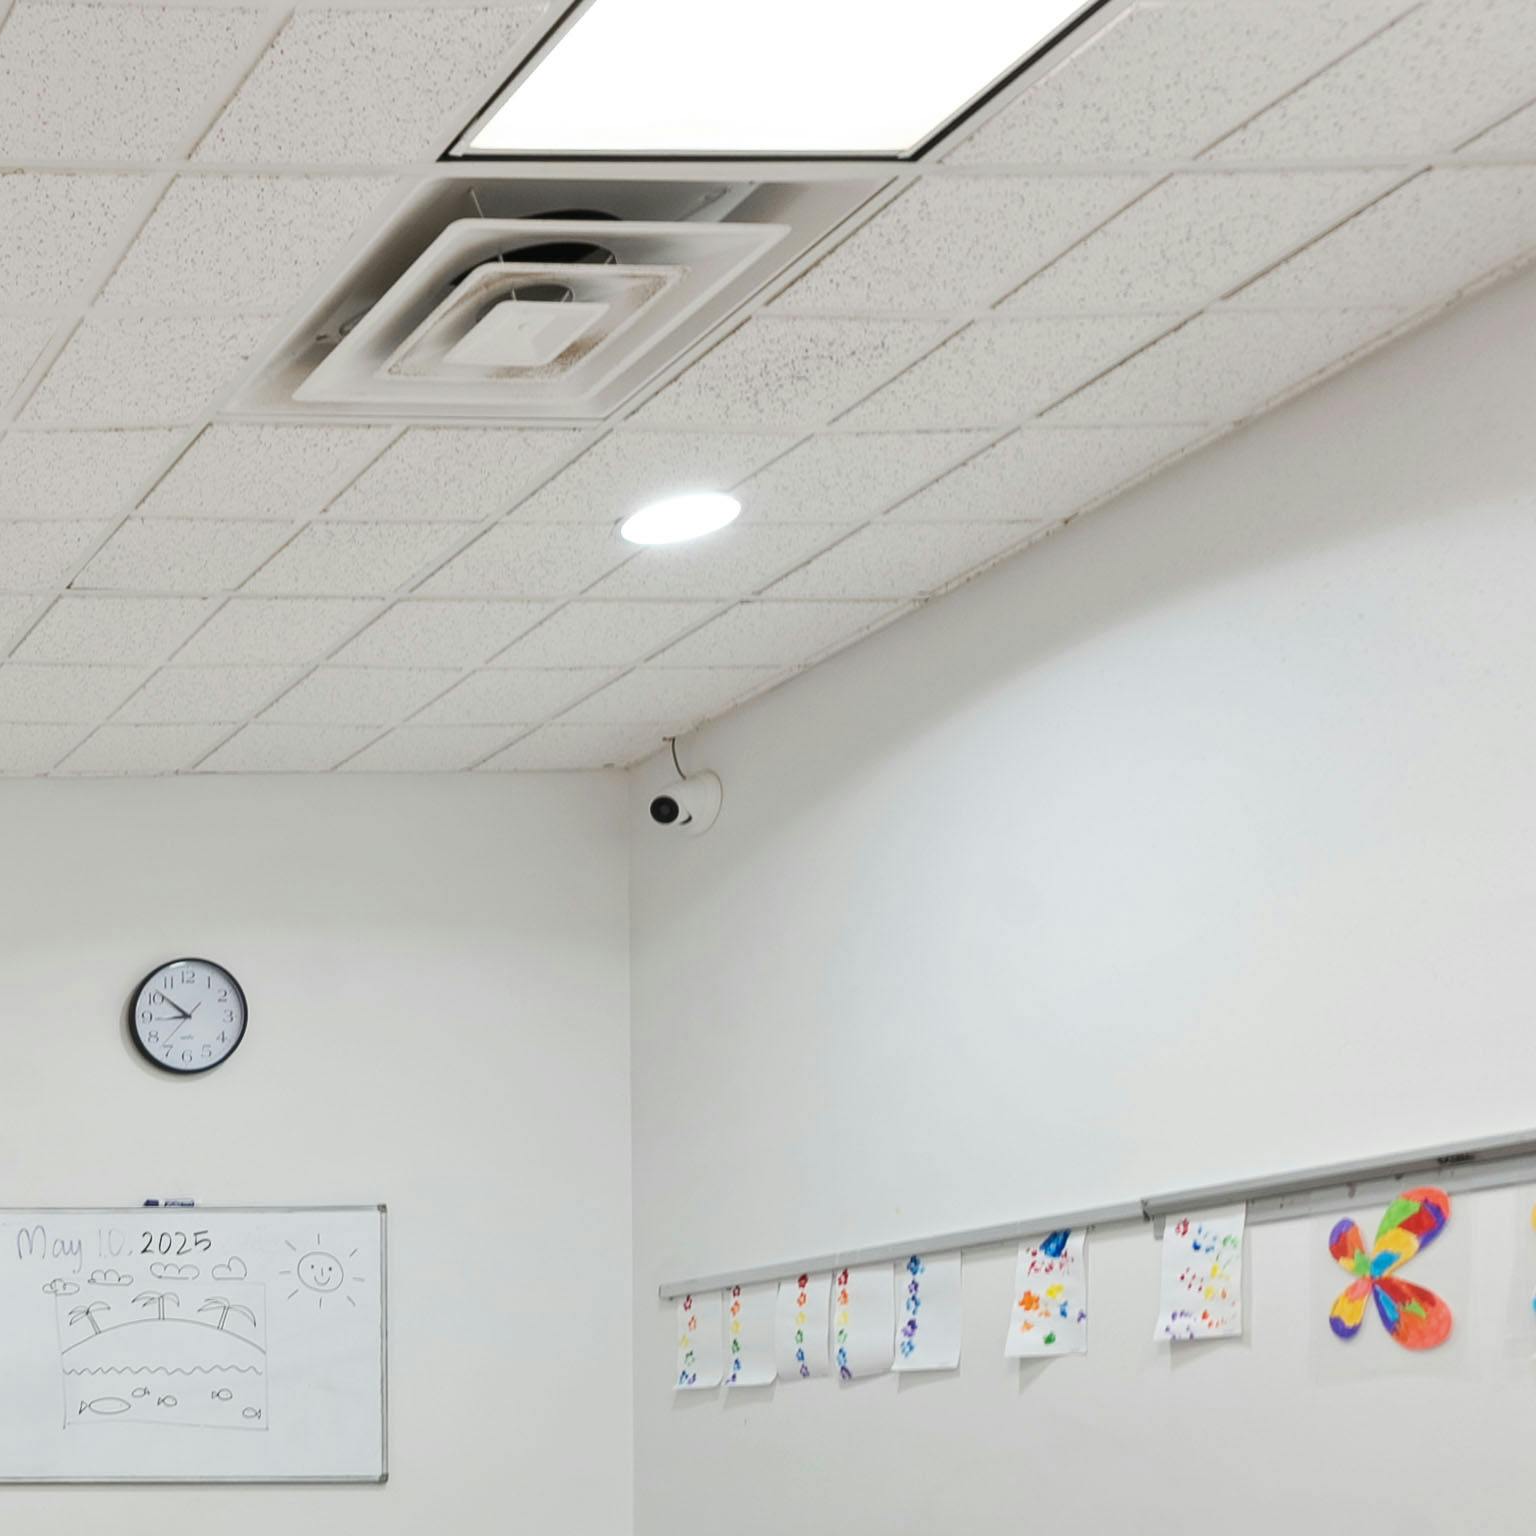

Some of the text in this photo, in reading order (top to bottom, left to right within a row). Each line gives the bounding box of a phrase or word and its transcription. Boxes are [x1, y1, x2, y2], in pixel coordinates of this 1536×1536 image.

[163, 976, 174, 989] 11
[181, 971, 195, 984] 12
[207, 975, 211, 989] 1
[217, 989, 228, 1003] 2
[141, 1010, 153, 1024] 9
[223, 1009, 234, 1023] 3
[147, 1031, 159, 1043] 8
[216, 1031, 227, 1043] 4
[162, 1044, 174, 1058] 7
[181, 1048, 193, 1063] 6
[201, 1044, 212, 1058] 5
[16, 1225, 83, 1274] May
[140, 1230, 212, 1255] 2025
